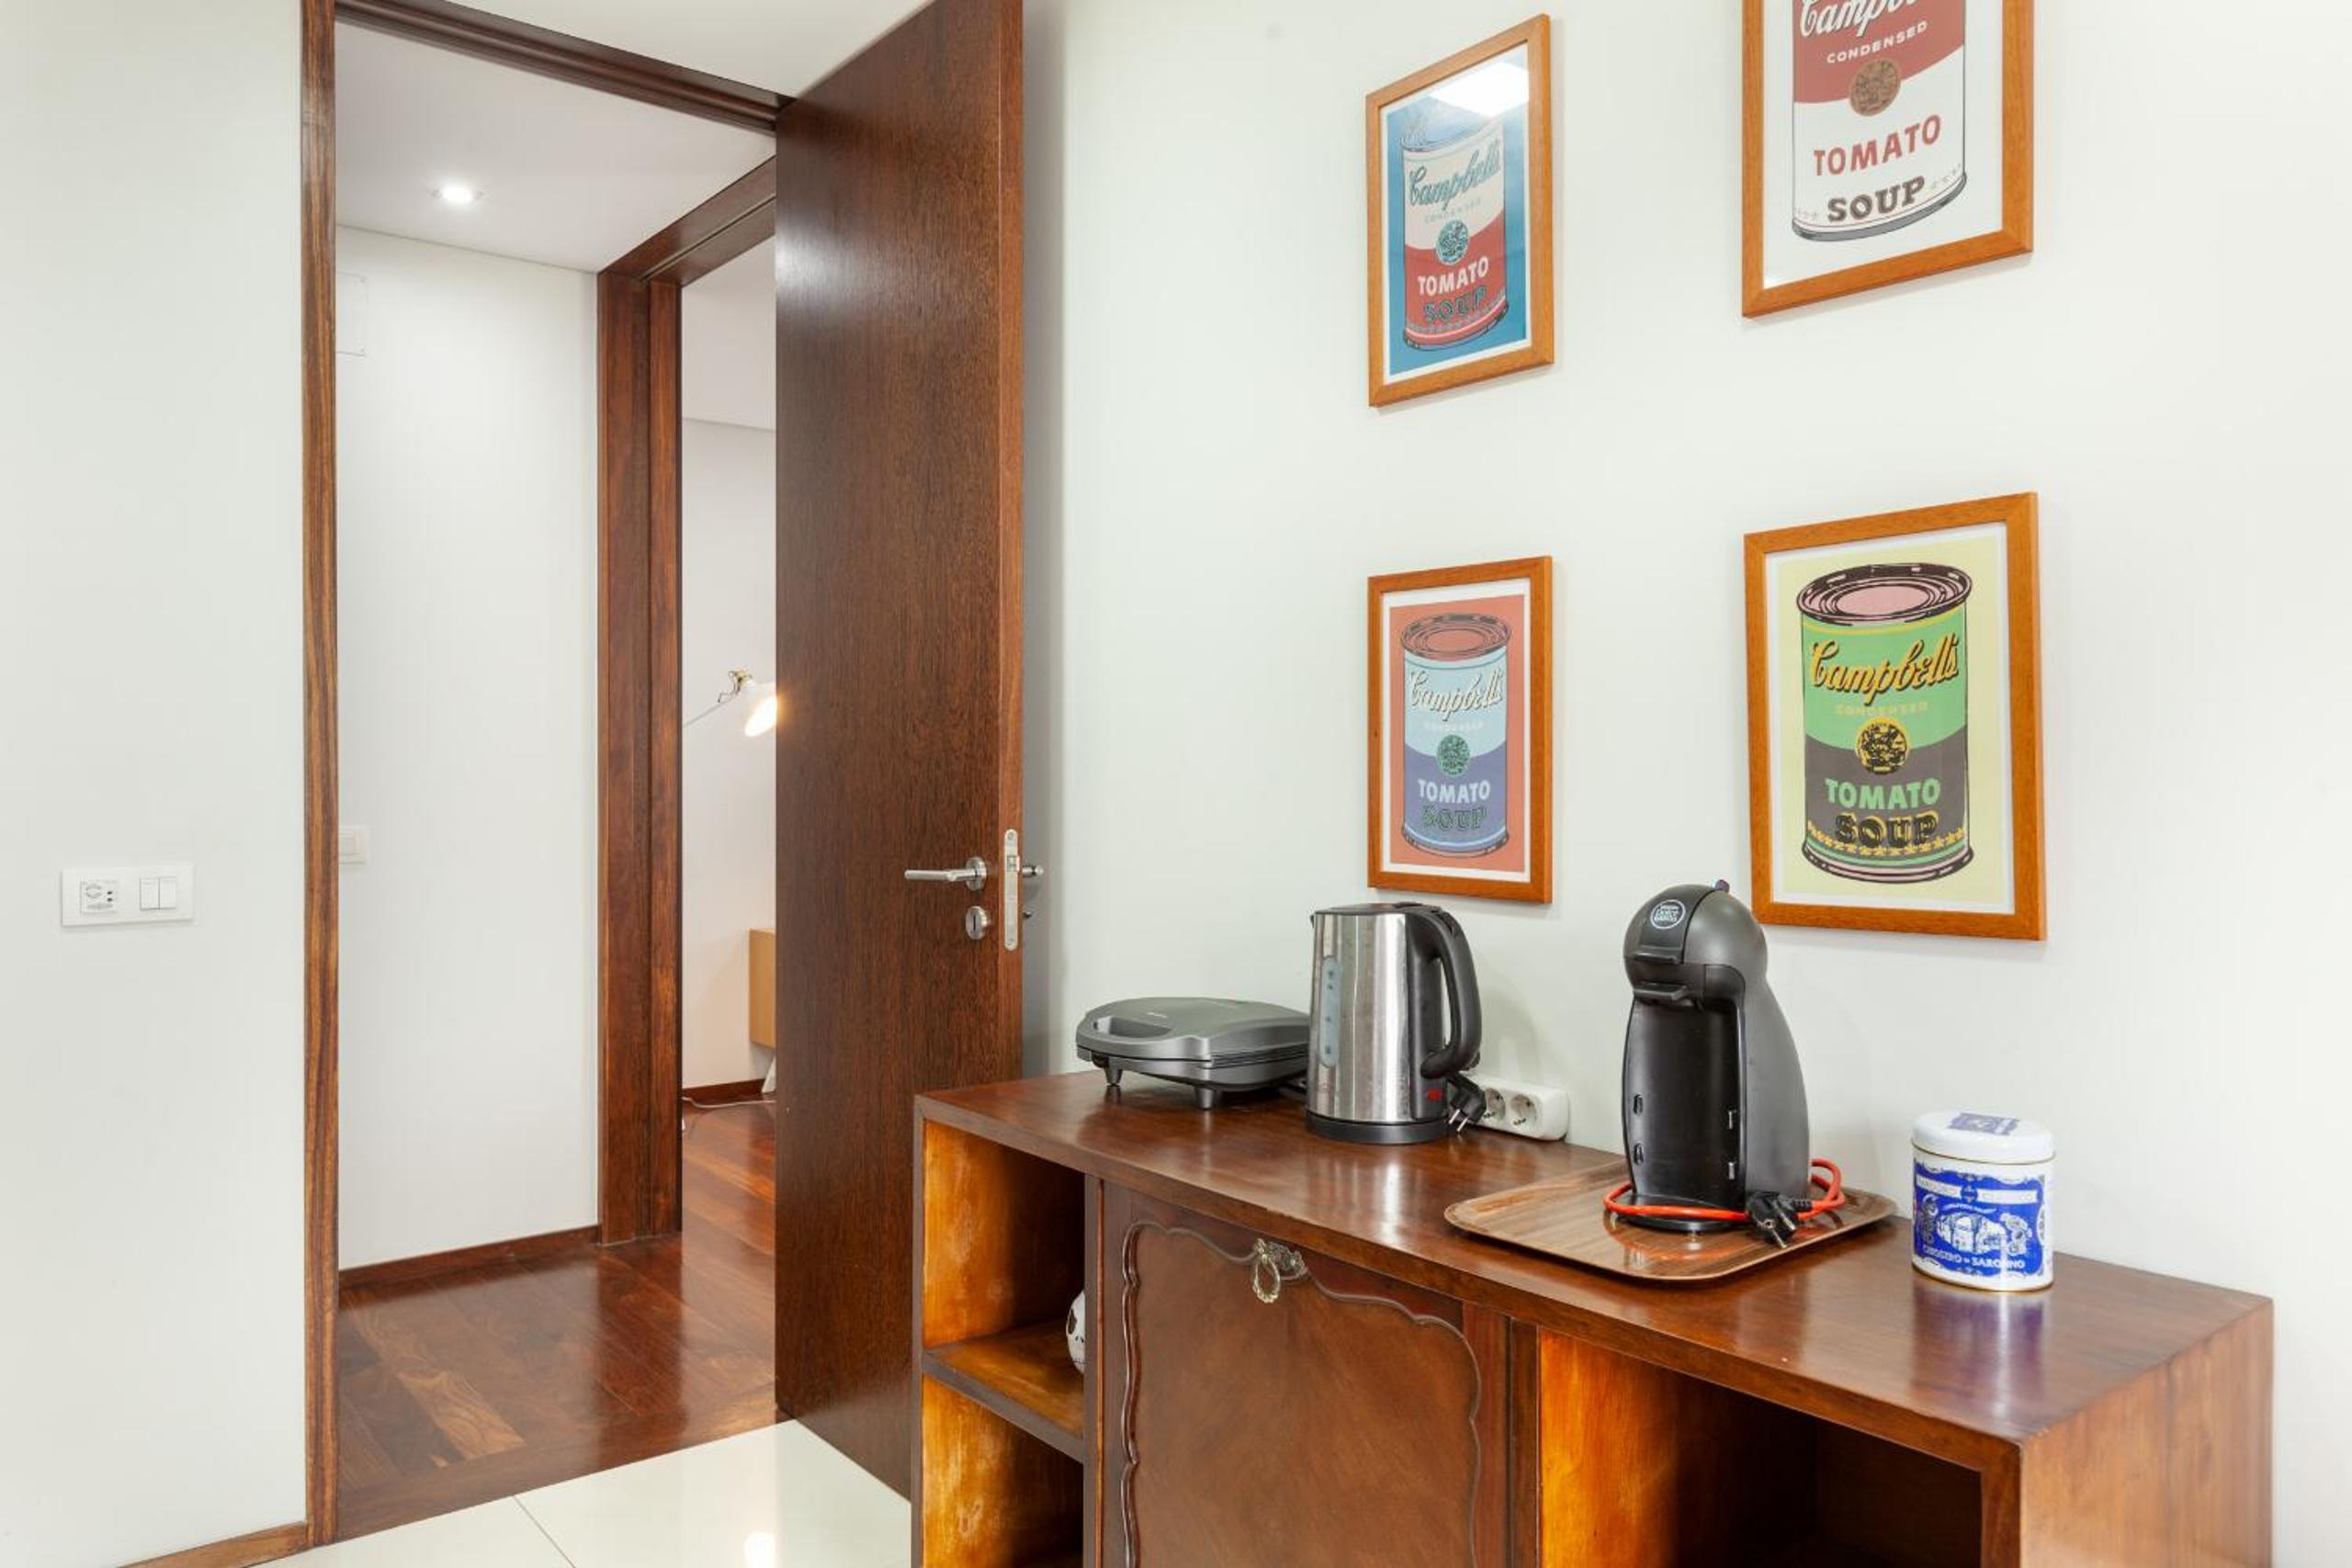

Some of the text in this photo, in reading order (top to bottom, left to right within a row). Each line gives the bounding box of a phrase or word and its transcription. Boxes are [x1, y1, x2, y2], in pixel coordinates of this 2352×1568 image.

[1826, 20, 1928, 63] CONDENSED
[1814, 114, 1941, 176] TOMATO
[1827, 175, 1926, 223] SOUP
[1418, 255, 1489, 297] TOMATO
[1423, 285, 1487, 324] SOUP
[1418, 779, 1490, 805] TOMATO
[1825, 777, 1941, 810] TOMATO
[1423, 804, 1488, 831] SOUP
[1834, 810, 1939, 846] SOUP
